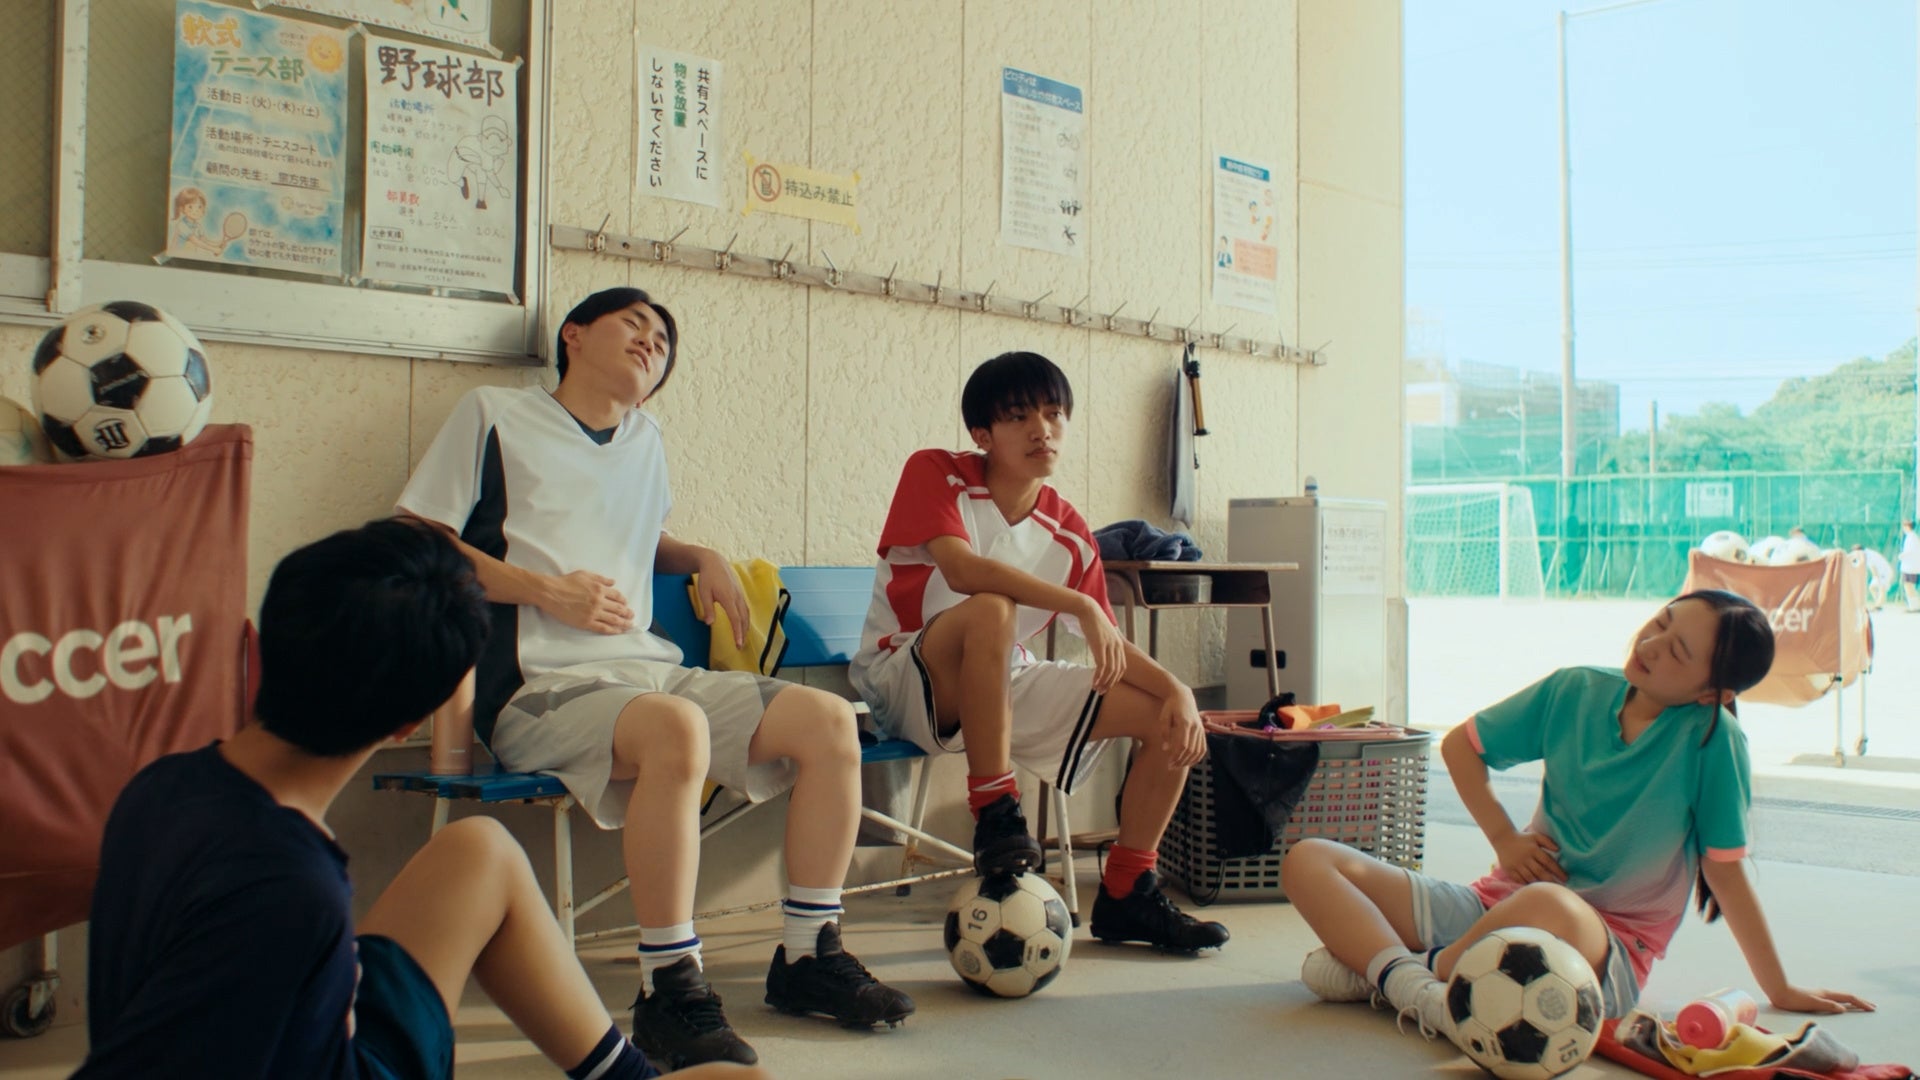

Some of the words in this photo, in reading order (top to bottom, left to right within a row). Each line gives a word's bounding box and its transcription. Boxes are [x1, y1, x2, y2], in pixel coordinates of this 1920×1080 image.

[182, 14, 242, 48] 軟式
[211, 50, 305, 82] テニス部
[377, 45, 506, 108] 野球部
[673, 61, 688, 129] 物を放置
[650, 57, 664, 188] しないでください
[695, 67, 710, 181] 共有スペースに
[784, 178, 854, 207] 持込み禁止
[1763, 607, 1814, 633] cer
[967, 908, 988, 931] 16
[1557, 1038, 1579, 1064] 15
